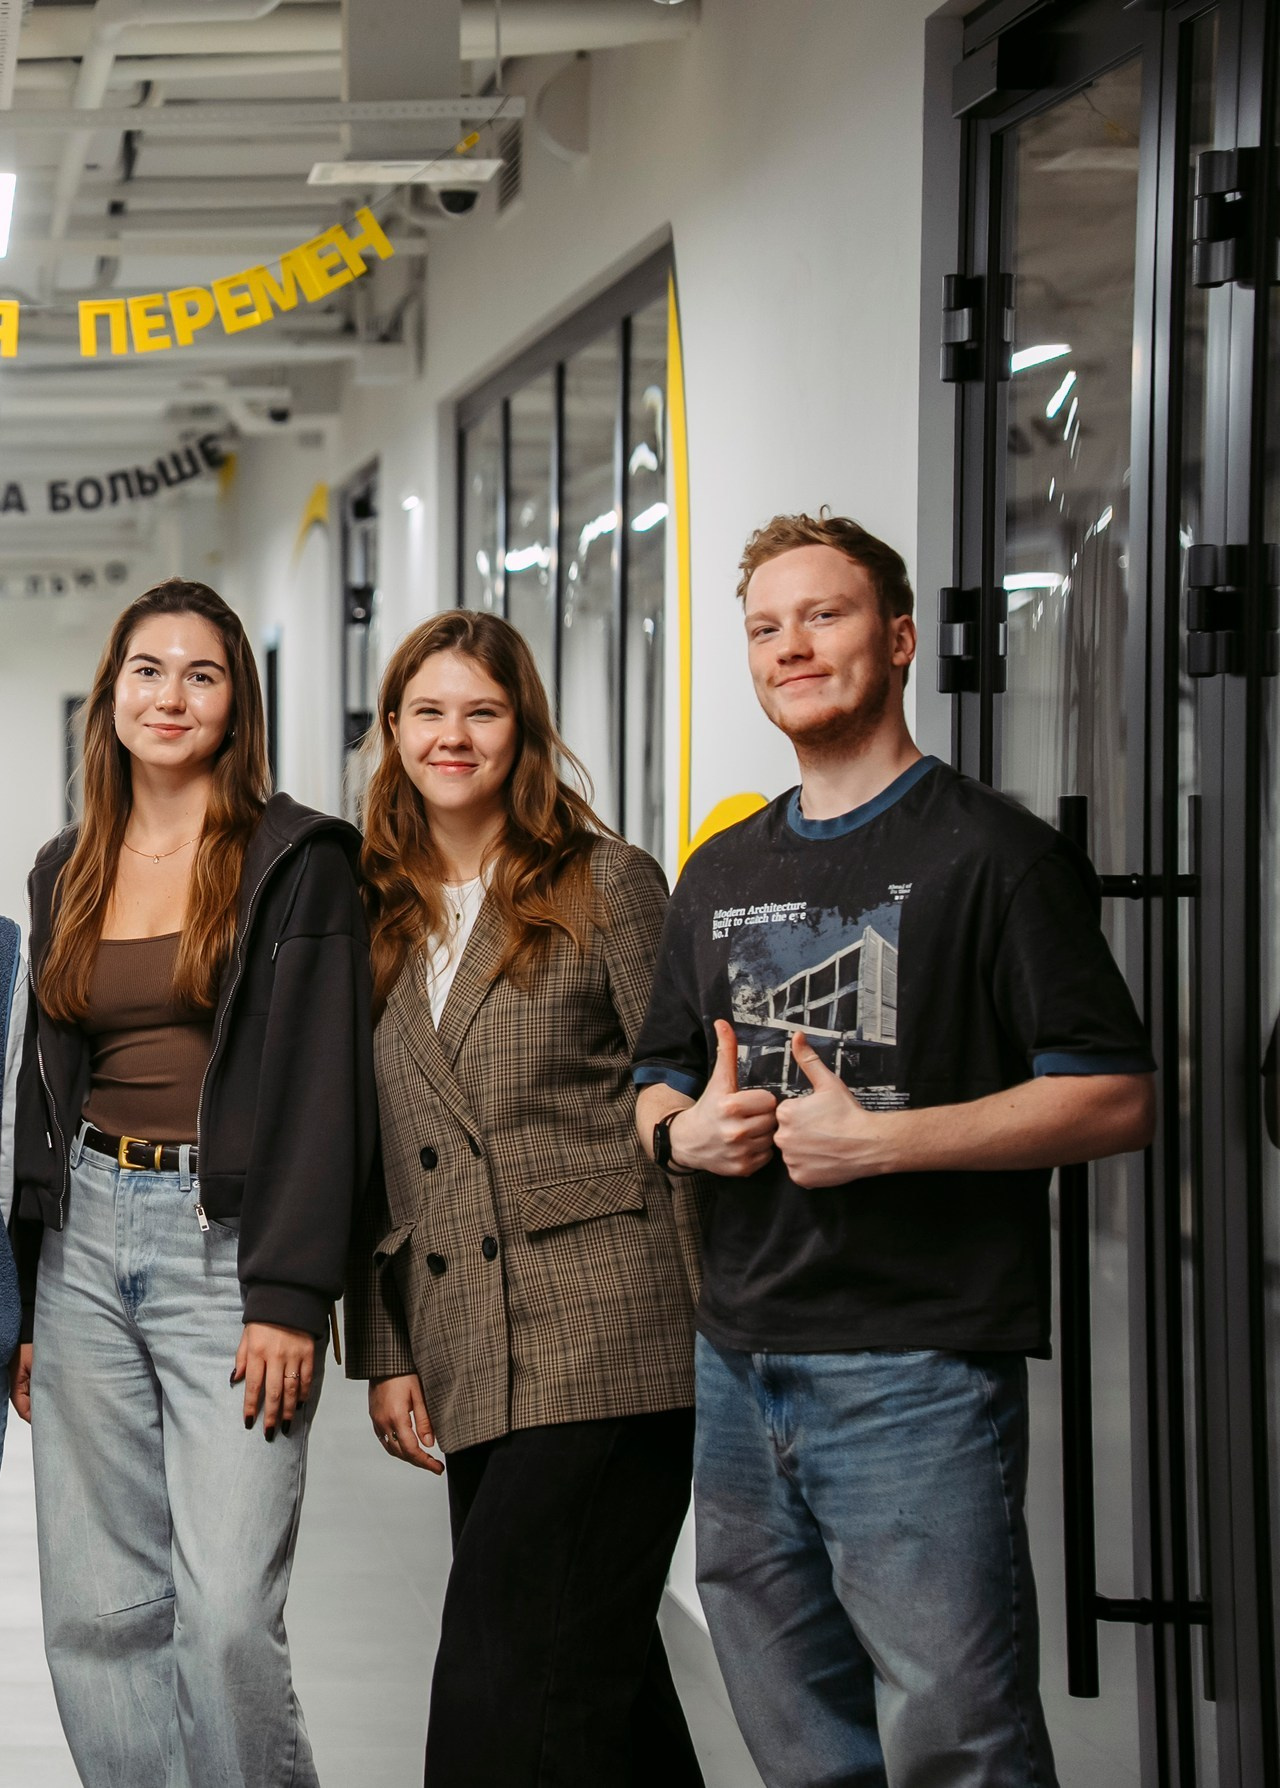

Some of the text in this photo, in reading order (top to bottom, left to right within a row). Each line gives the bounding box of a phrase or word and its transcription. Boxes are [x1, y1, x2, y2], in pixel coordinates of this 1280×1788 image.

[78, 205, 395, 357] ПЕРЕМЕН
[47, 432, 226, 513] БОЛЬШЕ
[713, 902, 807, 919] Modern Architecture
[713, 918, 732, 930] Built
[733, 917, 742, 926] to
[744, 913, 769, 925] catch
[771, 912, 787, 922] the
[712, 928, 729, 940] No.1
